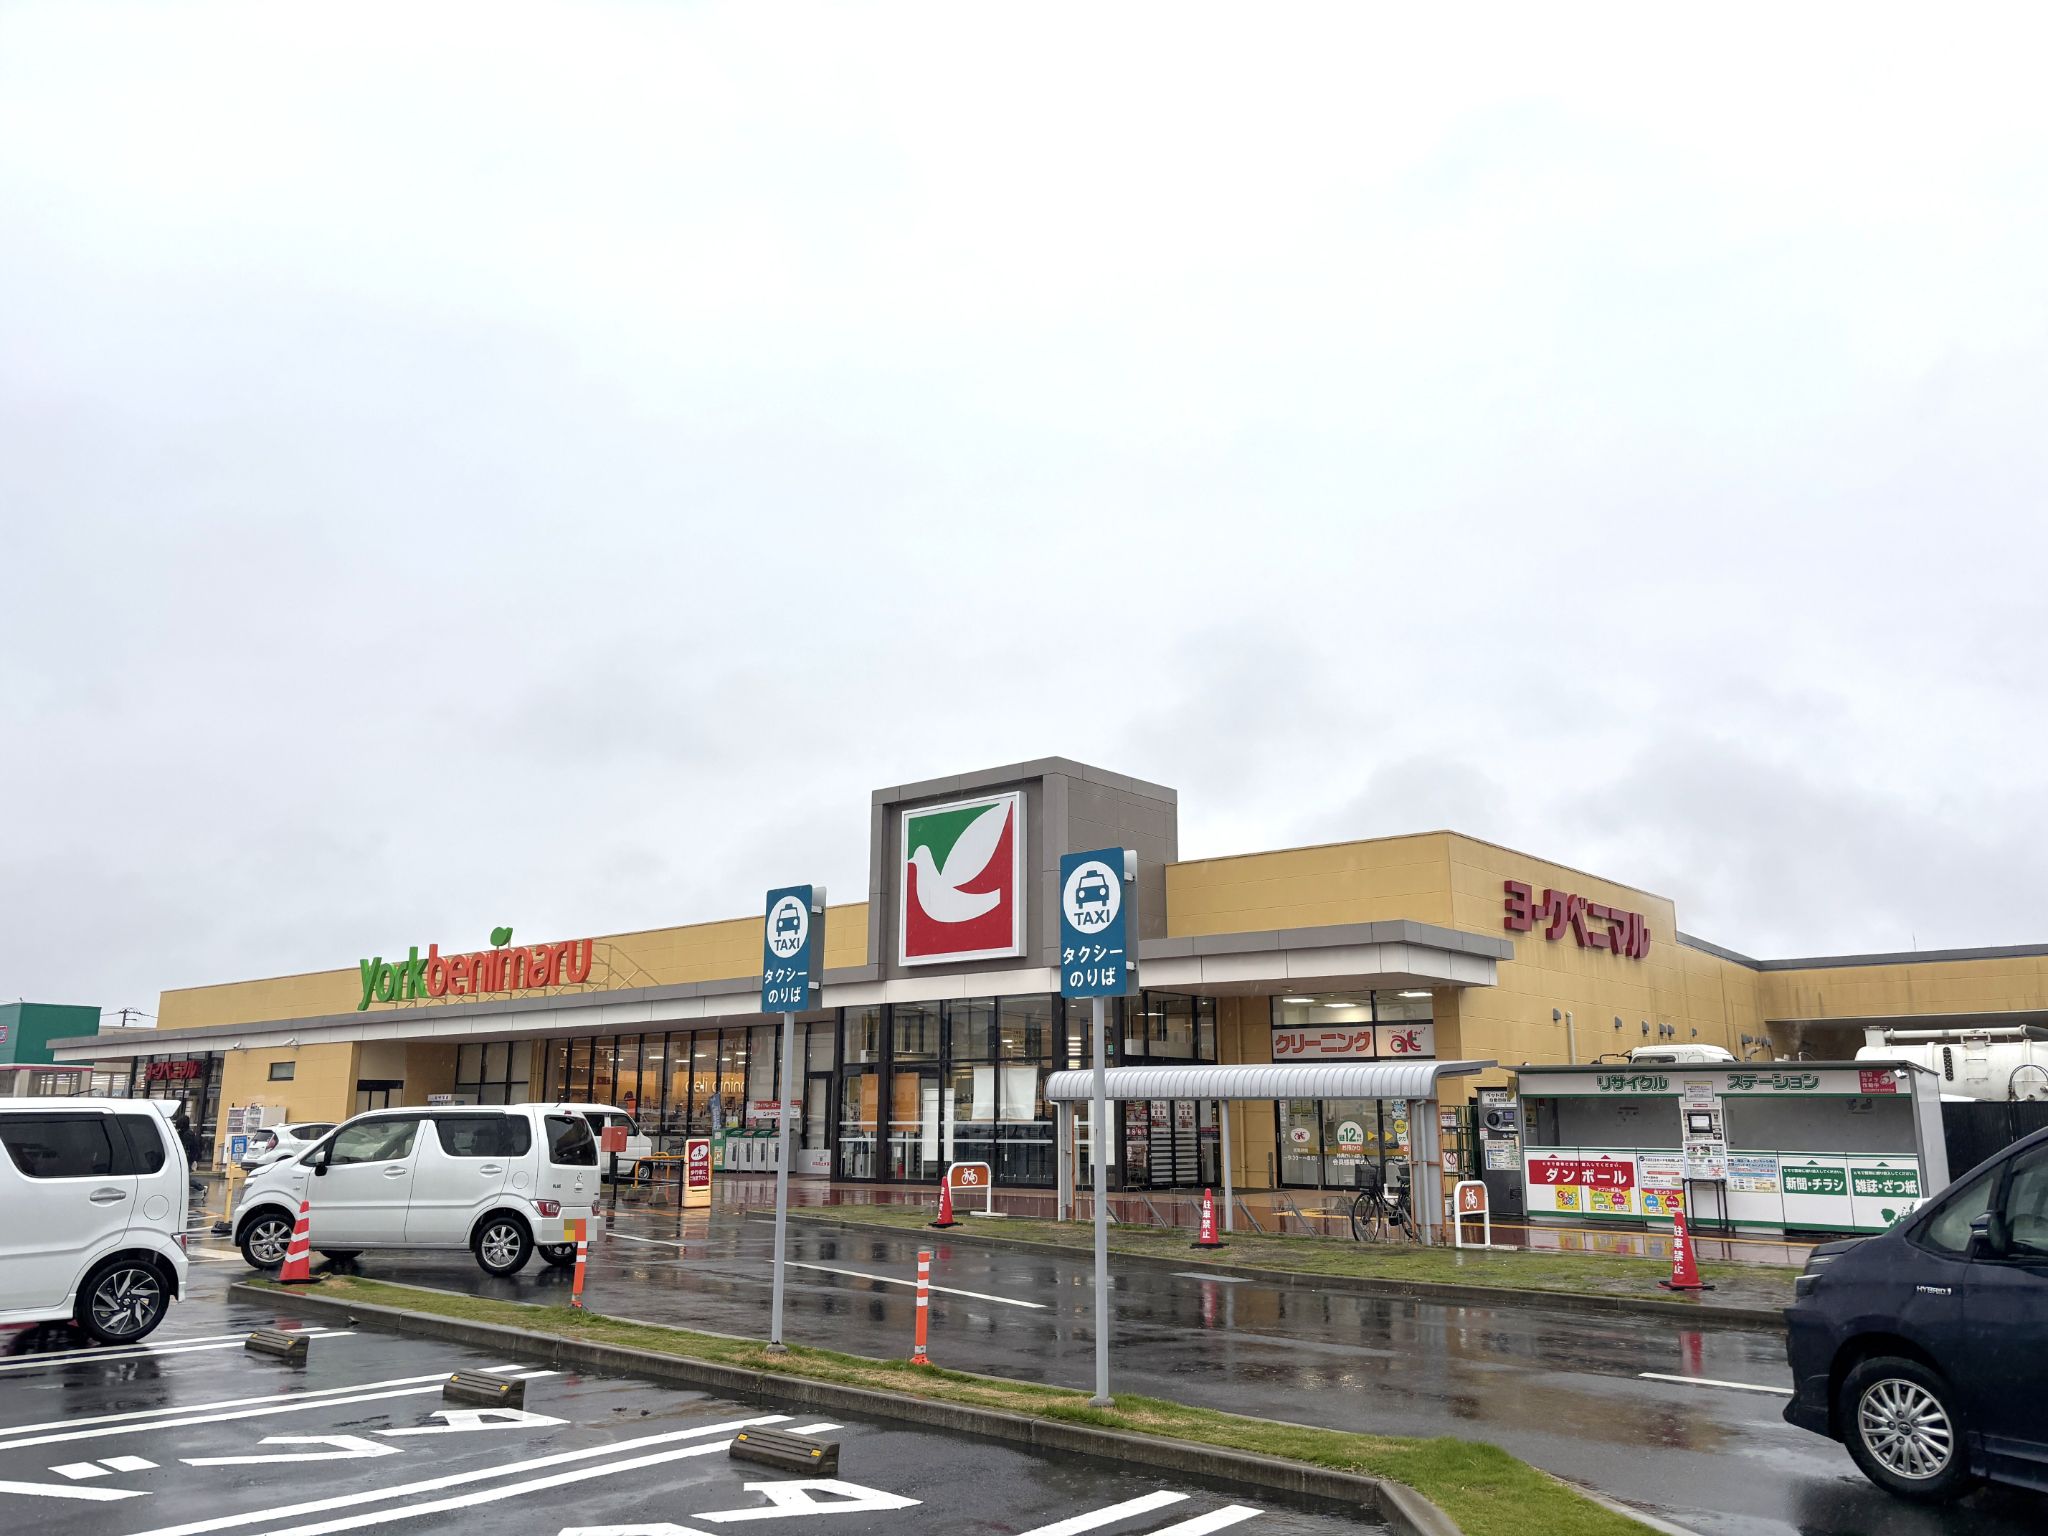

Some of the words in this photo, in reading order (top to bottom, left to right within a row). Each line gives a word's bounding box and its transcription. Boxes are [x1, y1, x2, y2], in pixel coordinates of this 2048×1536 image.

[1074, 909, 1110, 926] TAXI
[1504, 880, 1651, 959] ヨークベニマル
[774, 938, 800, 951] TAXI
[1063, 944, 1123, 965] タクシー
[764, 967, 808, 984] タクシー
[1069, 966, 1116, 987] のりば
[768, 986, 802, 1003] のりば
[1275, 1031, 1371, 1054] クリーニング
[1597, 1074, 1669, 1091] リサイクル
[1727, 1074, 1821, 1090] ステーション
[1546, 1168, 1627, 1184] ダンボール
[1785, 1177, 1844, 1192] 新聞・チラシ
[1855, 1179, 1918, 1194] 雑誌・ざつ紙
[1673, 1225, 1684, 1275] 駐車禁止
[1916, 1285, 1946, 1295] HYBRID
